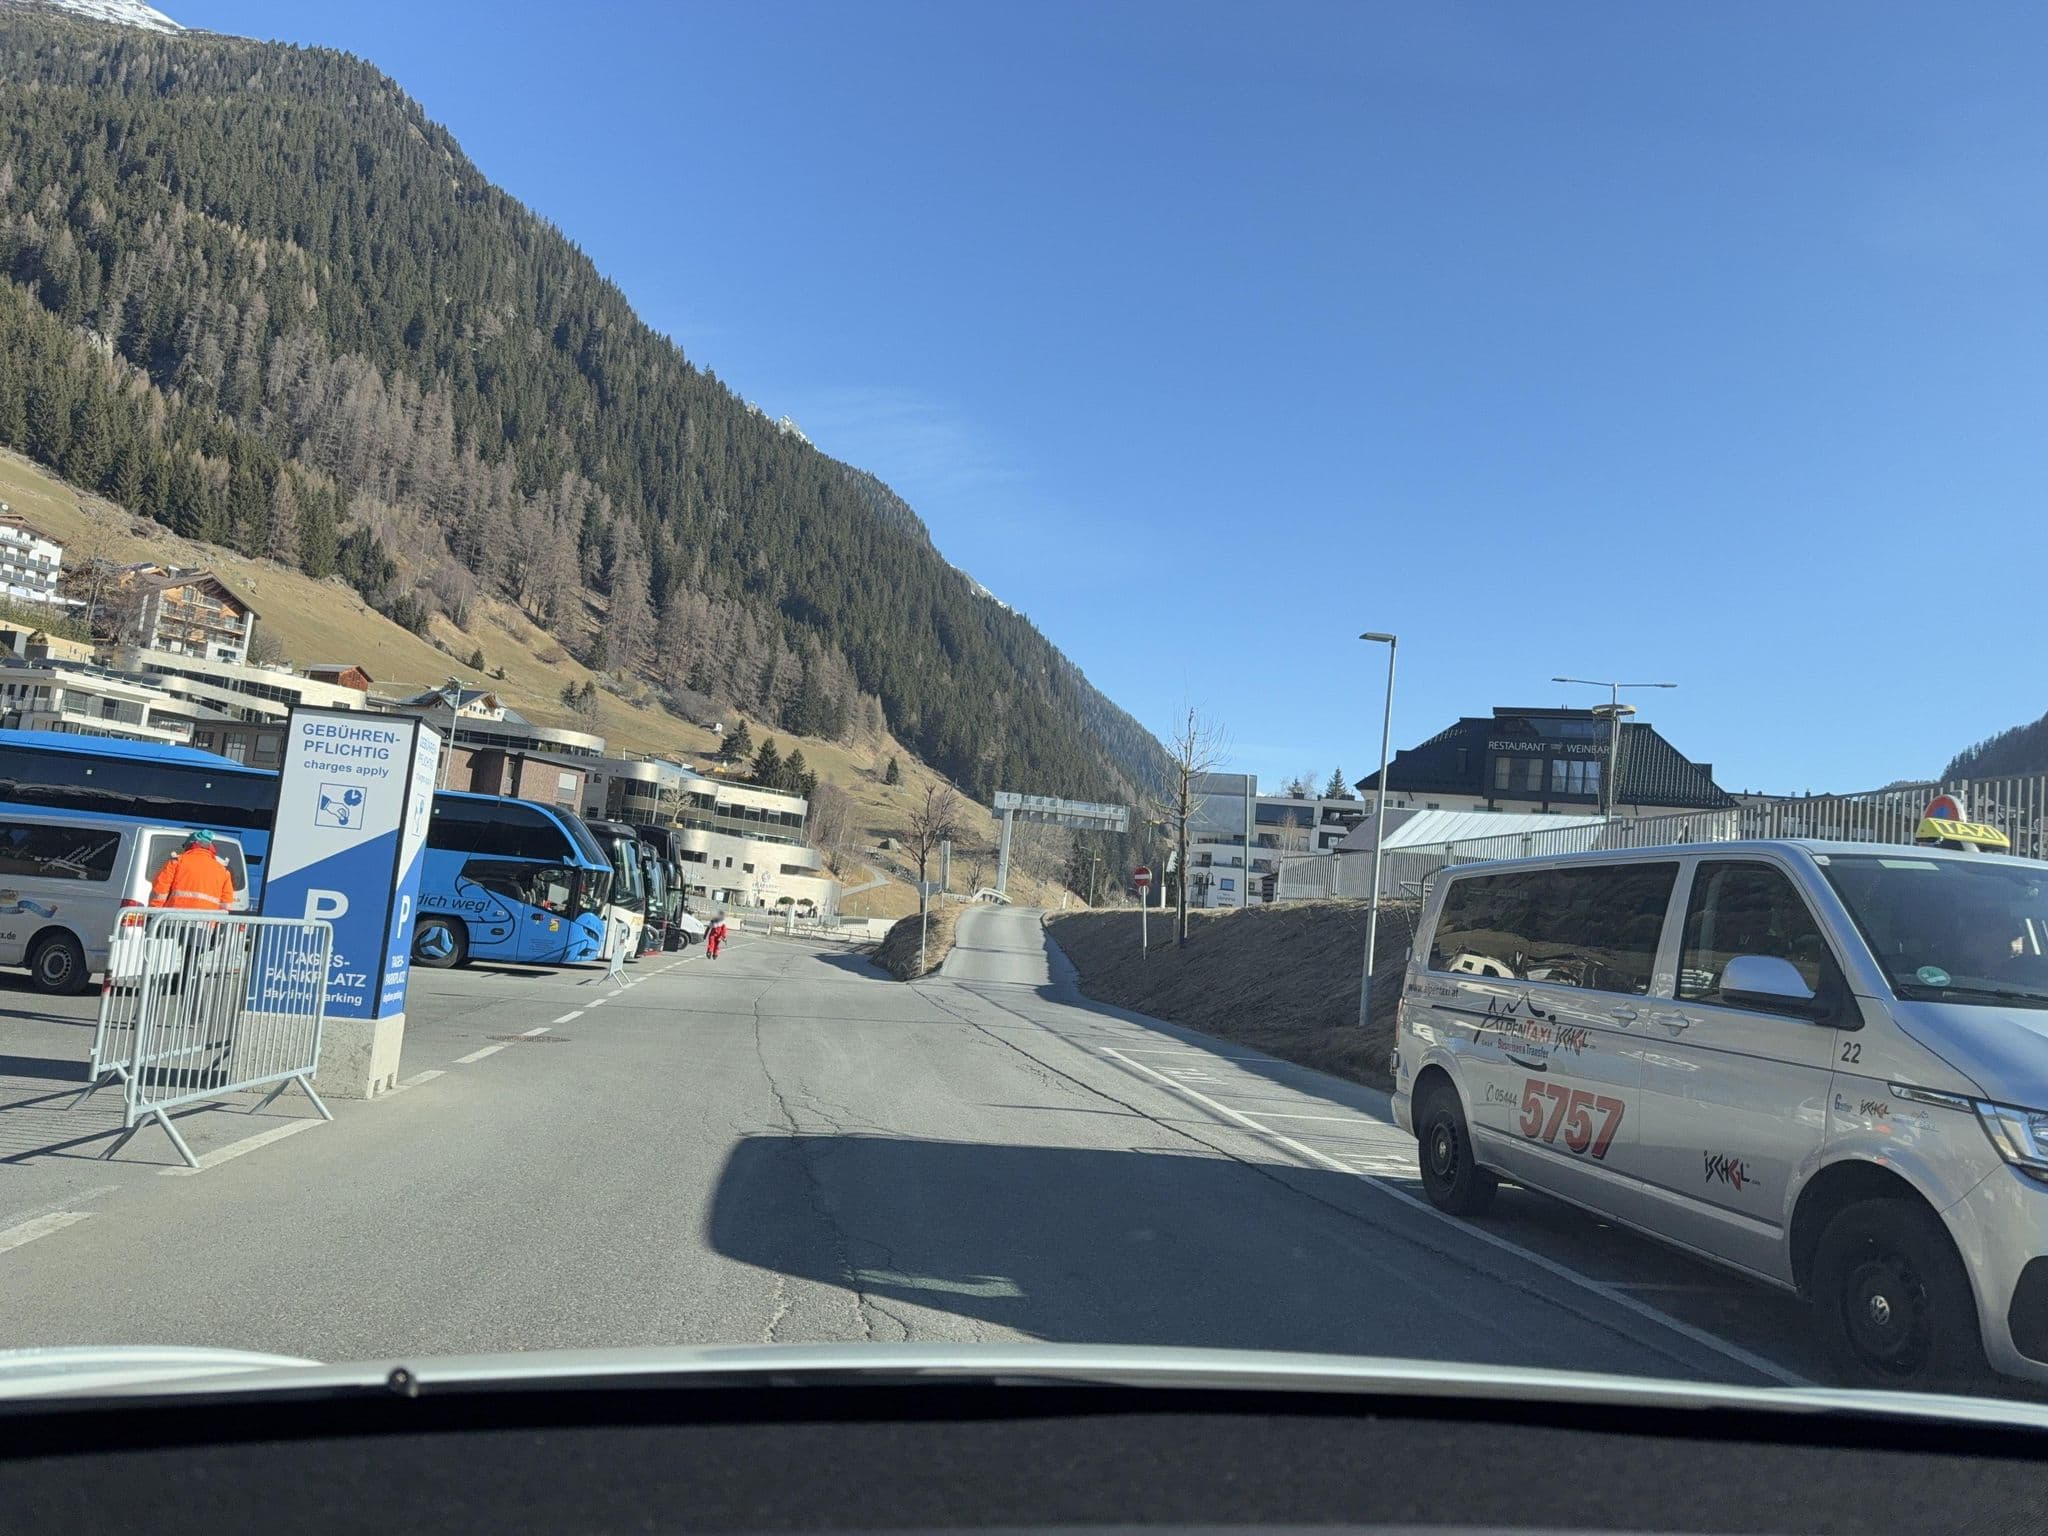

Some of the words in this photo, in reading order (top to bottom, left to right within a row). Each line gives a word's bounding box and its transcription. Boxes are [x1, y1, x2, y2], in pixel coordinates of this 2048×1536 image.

[302, 722, 401, 744] GEBÜHREN-
[303, 740, 389, 760] PFLICHTIG
[1488, 741, 1546, 752] RESTAURANT
[1566, 743, 1610, 754] WEINBAR
[303, 759, 352, 774] charges
[356, 765, 389, 779] apply
[1937, 821, 2003, 840] TAXI
[303, 888, 349, 935] P
[397, 894, 411, 939] P
[452, 899, 492, 914] weg!
[263, 987, 313, 1001] dayime
[316, 992, 363, 1007] arking
[1841, 1041, 1862, 1064] 22
[1519, 1078, 1626, 1160] 5757
